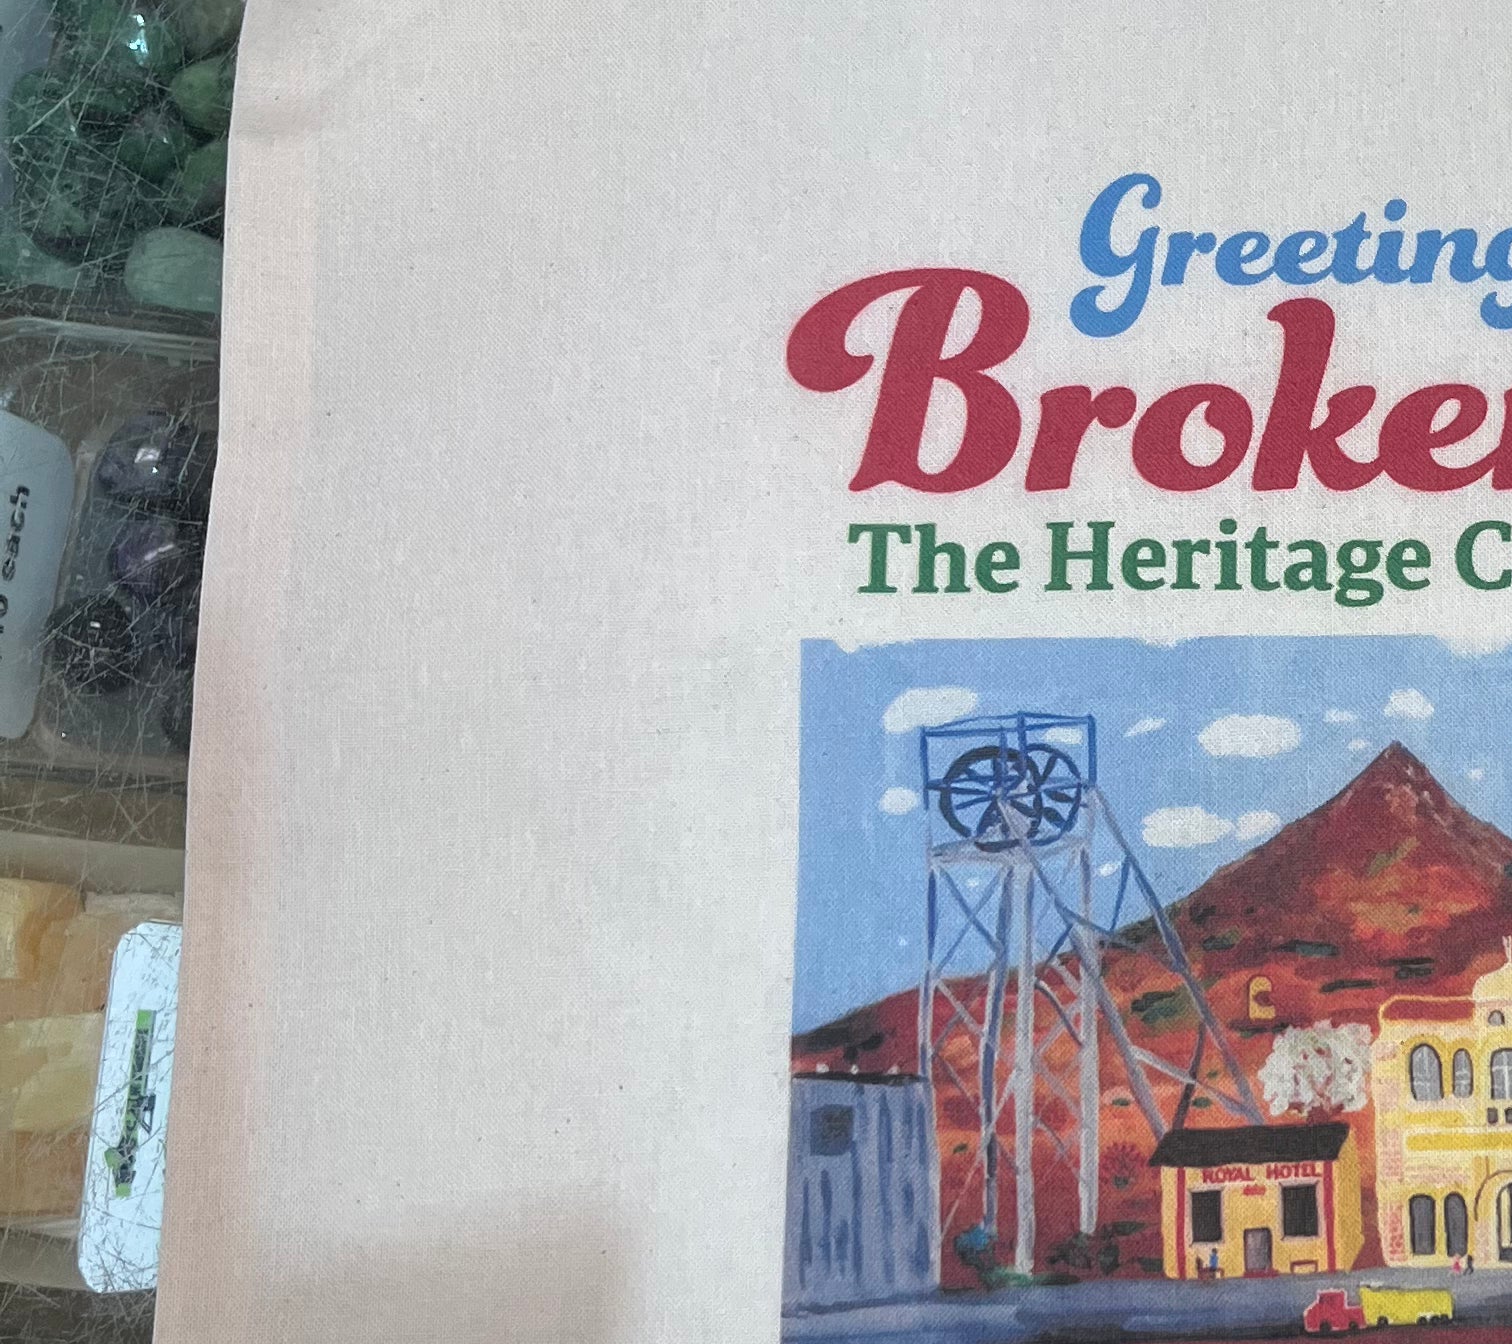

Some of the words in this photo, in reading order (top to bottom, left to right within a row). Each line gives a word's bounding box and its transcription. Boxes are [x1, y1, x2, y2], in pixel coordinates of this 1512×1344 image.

[1, 484, 30, 582] each
[847, 521, 1021, 594] The
[1043, 518, 1432, 608] Heritage
[1202, 1166, 1256, 1184] ROYAL
[1266, 1161, 1323, 1180] HOTEL
